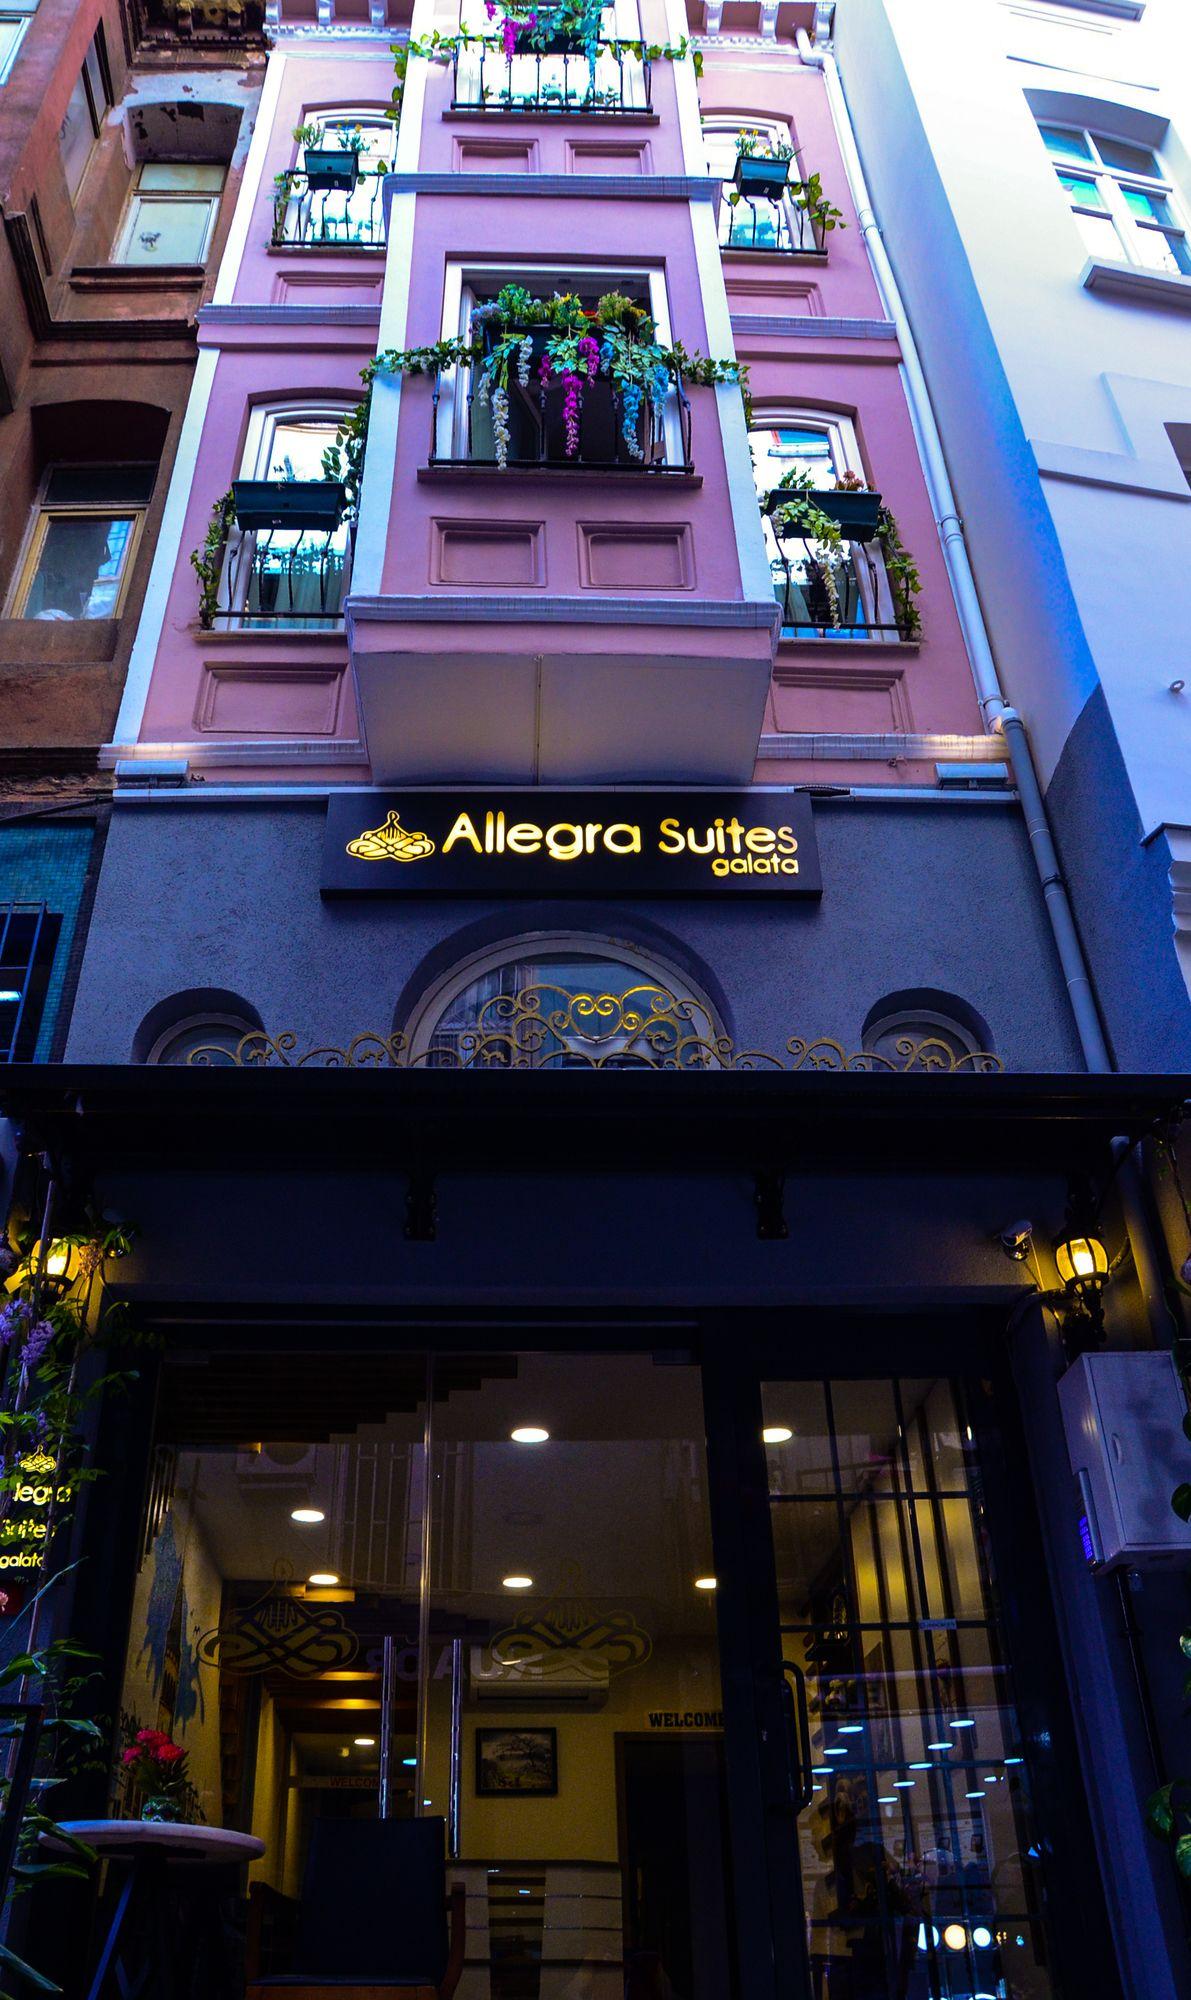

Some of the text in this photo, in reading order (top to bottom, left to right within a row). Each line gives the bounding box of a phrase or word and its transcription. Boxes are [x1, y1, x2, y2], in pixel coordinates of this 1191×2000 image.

[441, 810, 800, 861] Allegra Suites
[711, 851, 799, 878] galata
[648, 1711, 725, 1728] WELCOME
